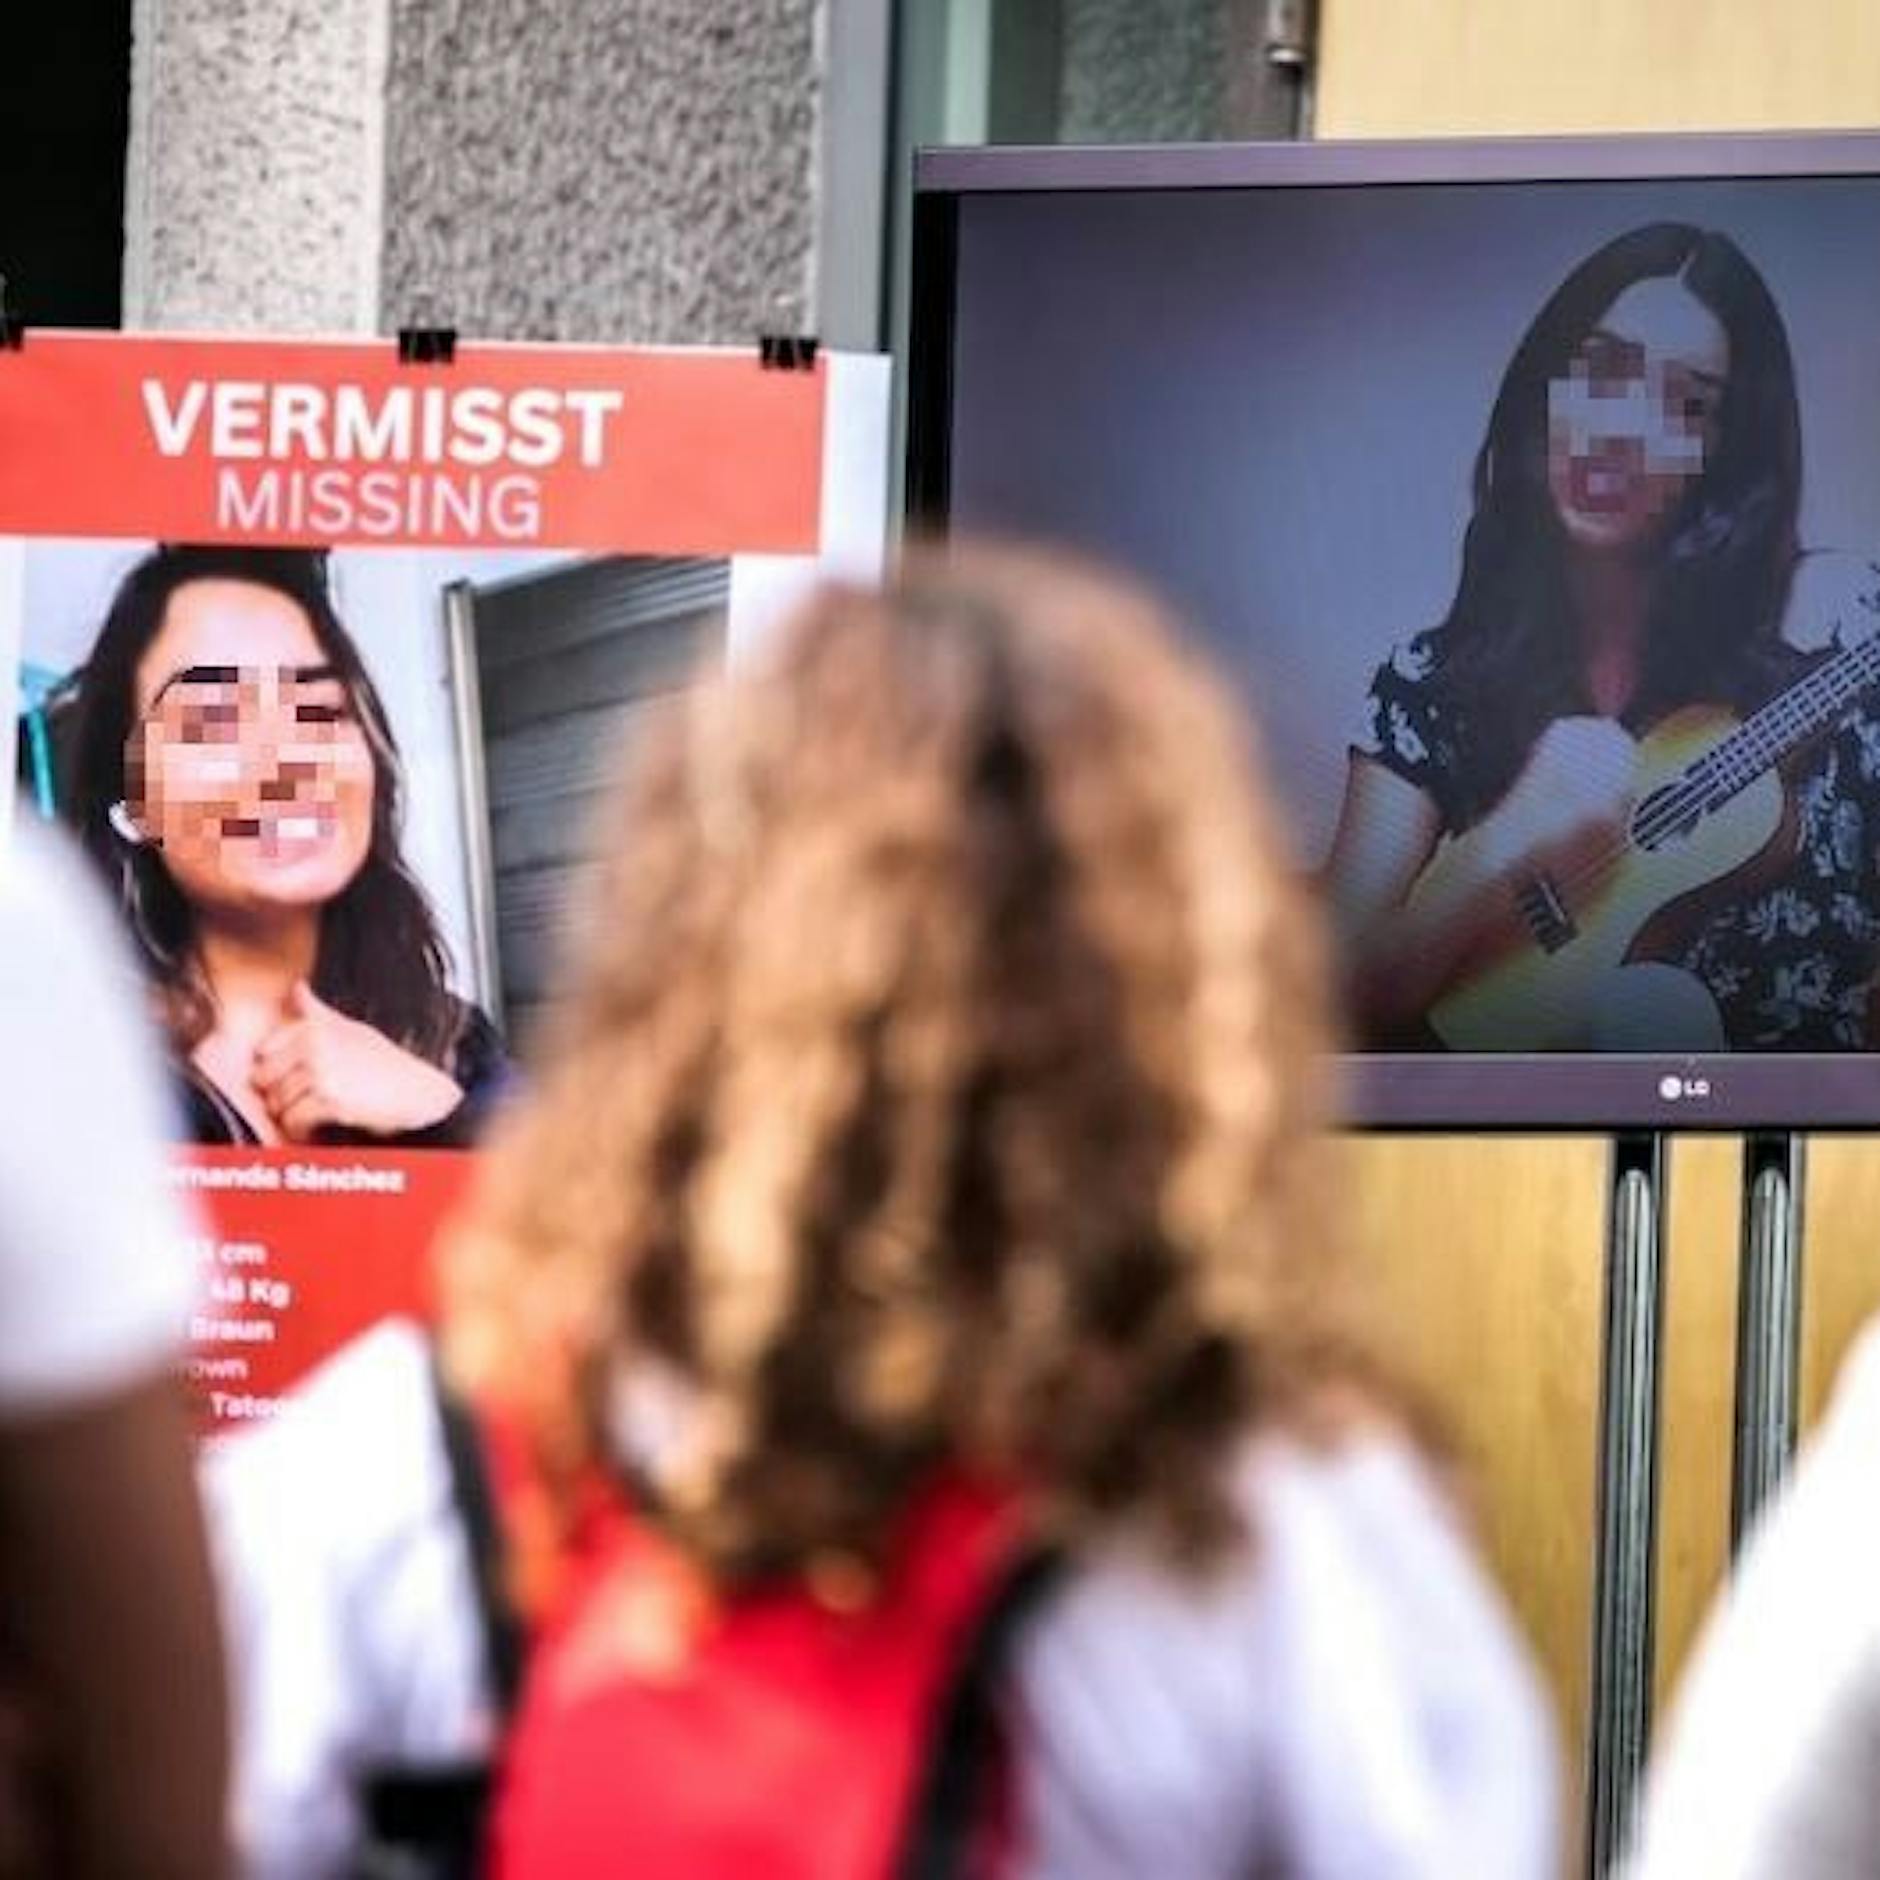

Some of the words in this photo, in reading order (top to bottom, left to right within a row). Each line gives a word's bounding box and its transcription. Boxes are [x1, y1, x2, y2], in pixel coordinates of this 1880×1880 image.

[141, 379, 625, 468] VERMISST
[216, 468, 540, 538] MISSING
[249, 1279, 291, 1308] Kg
